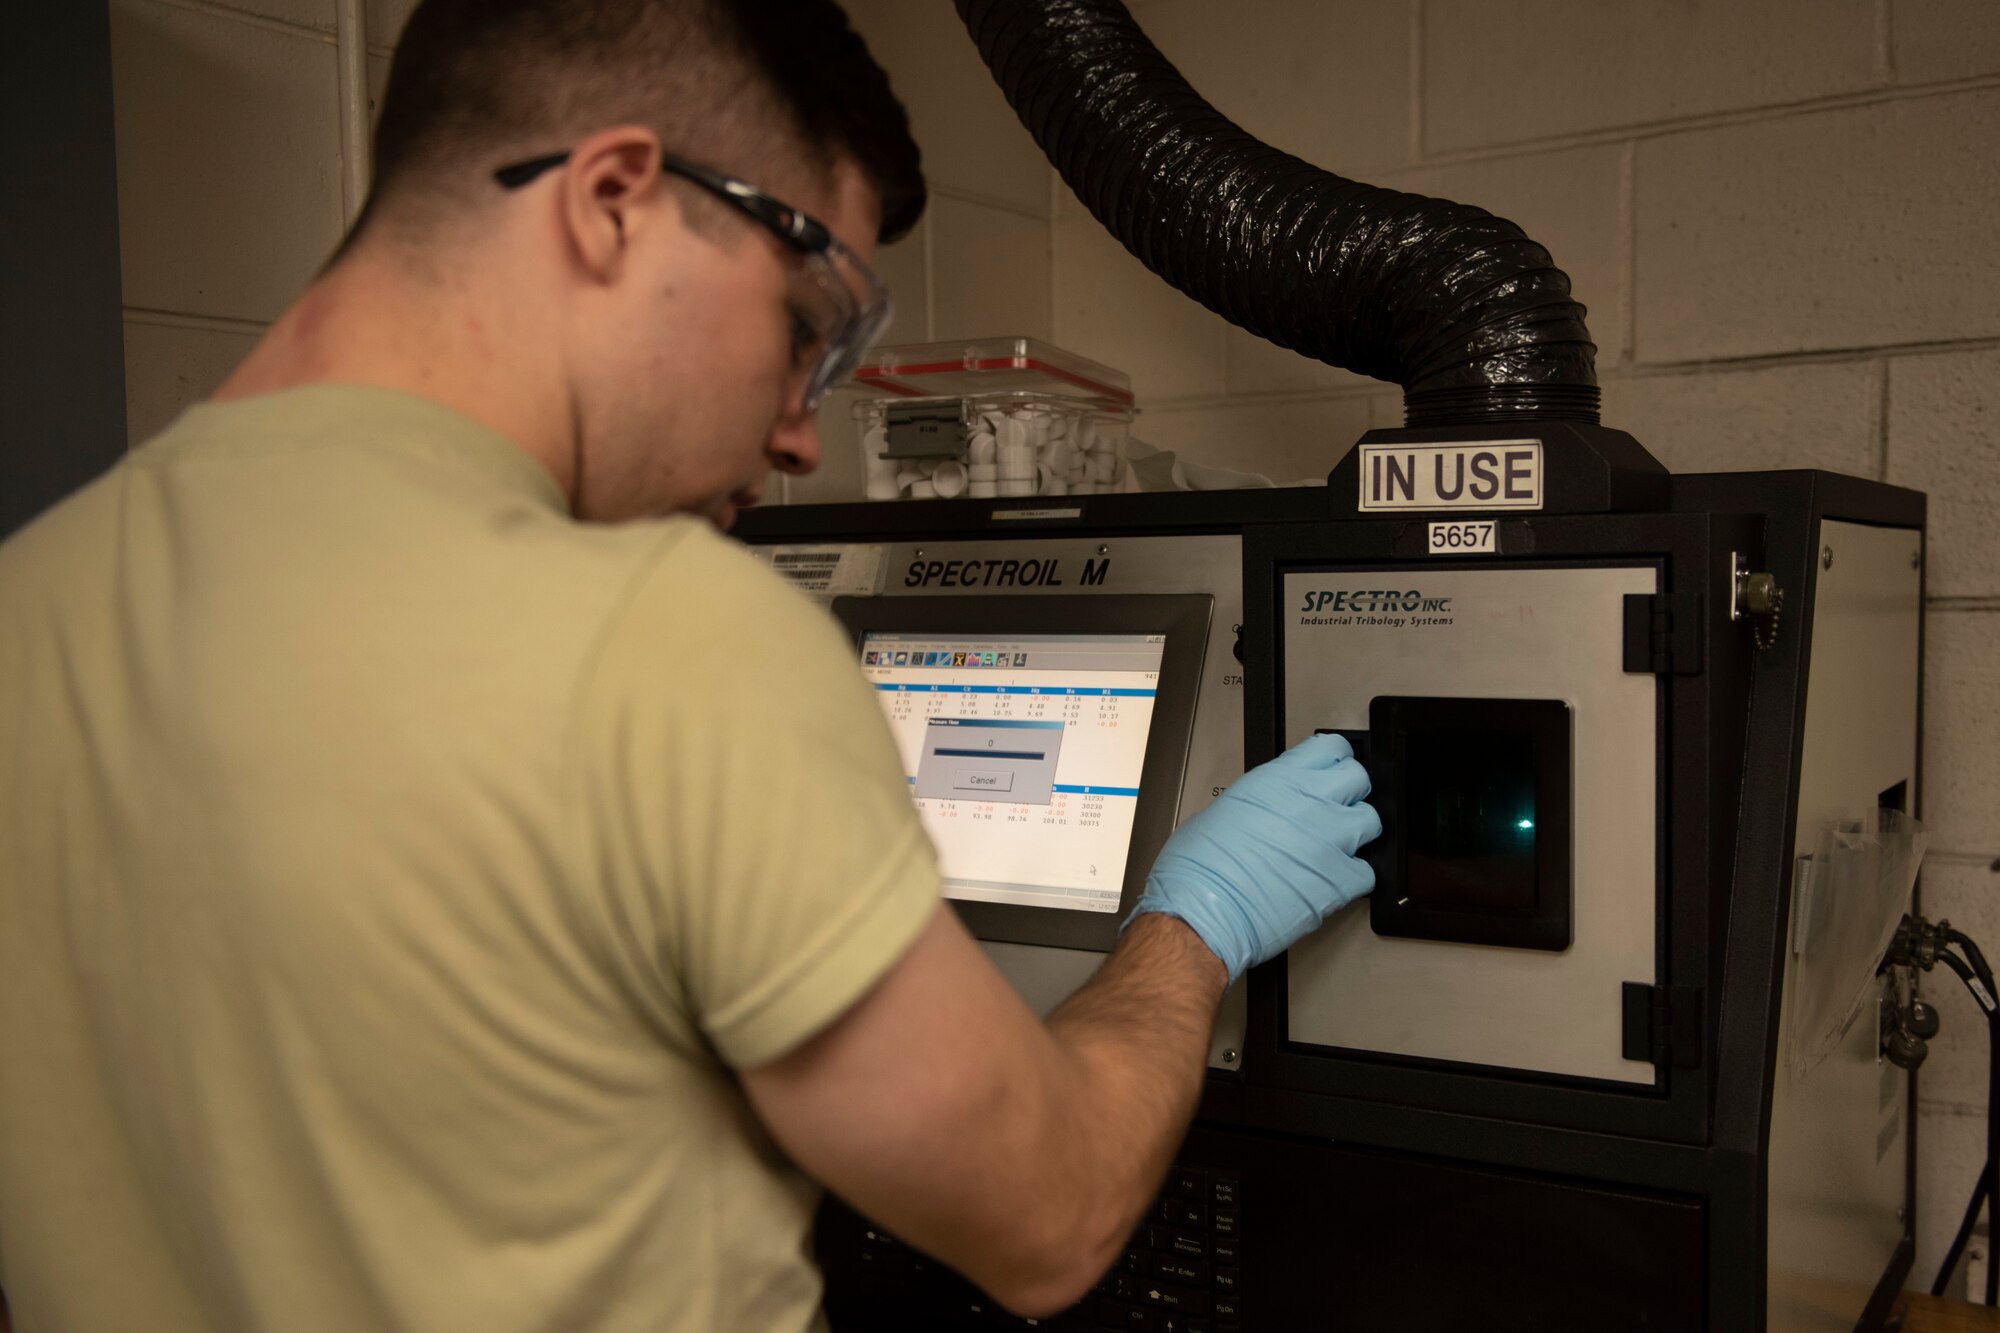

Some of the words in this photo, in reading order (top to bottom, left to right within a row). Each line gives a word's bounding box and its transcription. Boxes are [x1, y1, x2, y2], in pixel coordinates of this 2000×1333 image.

[1372, 454, 1416, 502] IN
[1433, 451, 1534, 500] USE
[1431, 524, 1492, 549] 5657
[904, 559, 1062, 588] SPECTROIL
[1079, 558, 1111, 586] M
[1301, 589, 1422, 612] SPECTRO
[1422, 599, 1452, 613] INC.
[1300, 616, 1352, 625] Industrial
[1356, 616, 1407, 628] Tribology
[1410, 616, 1454, 627] Systems
[970, 775, 997, 786] Cancel
[1178, 1267, 1196, 1278] Enter
[1163, 1294, 1179, 1304] Shift
